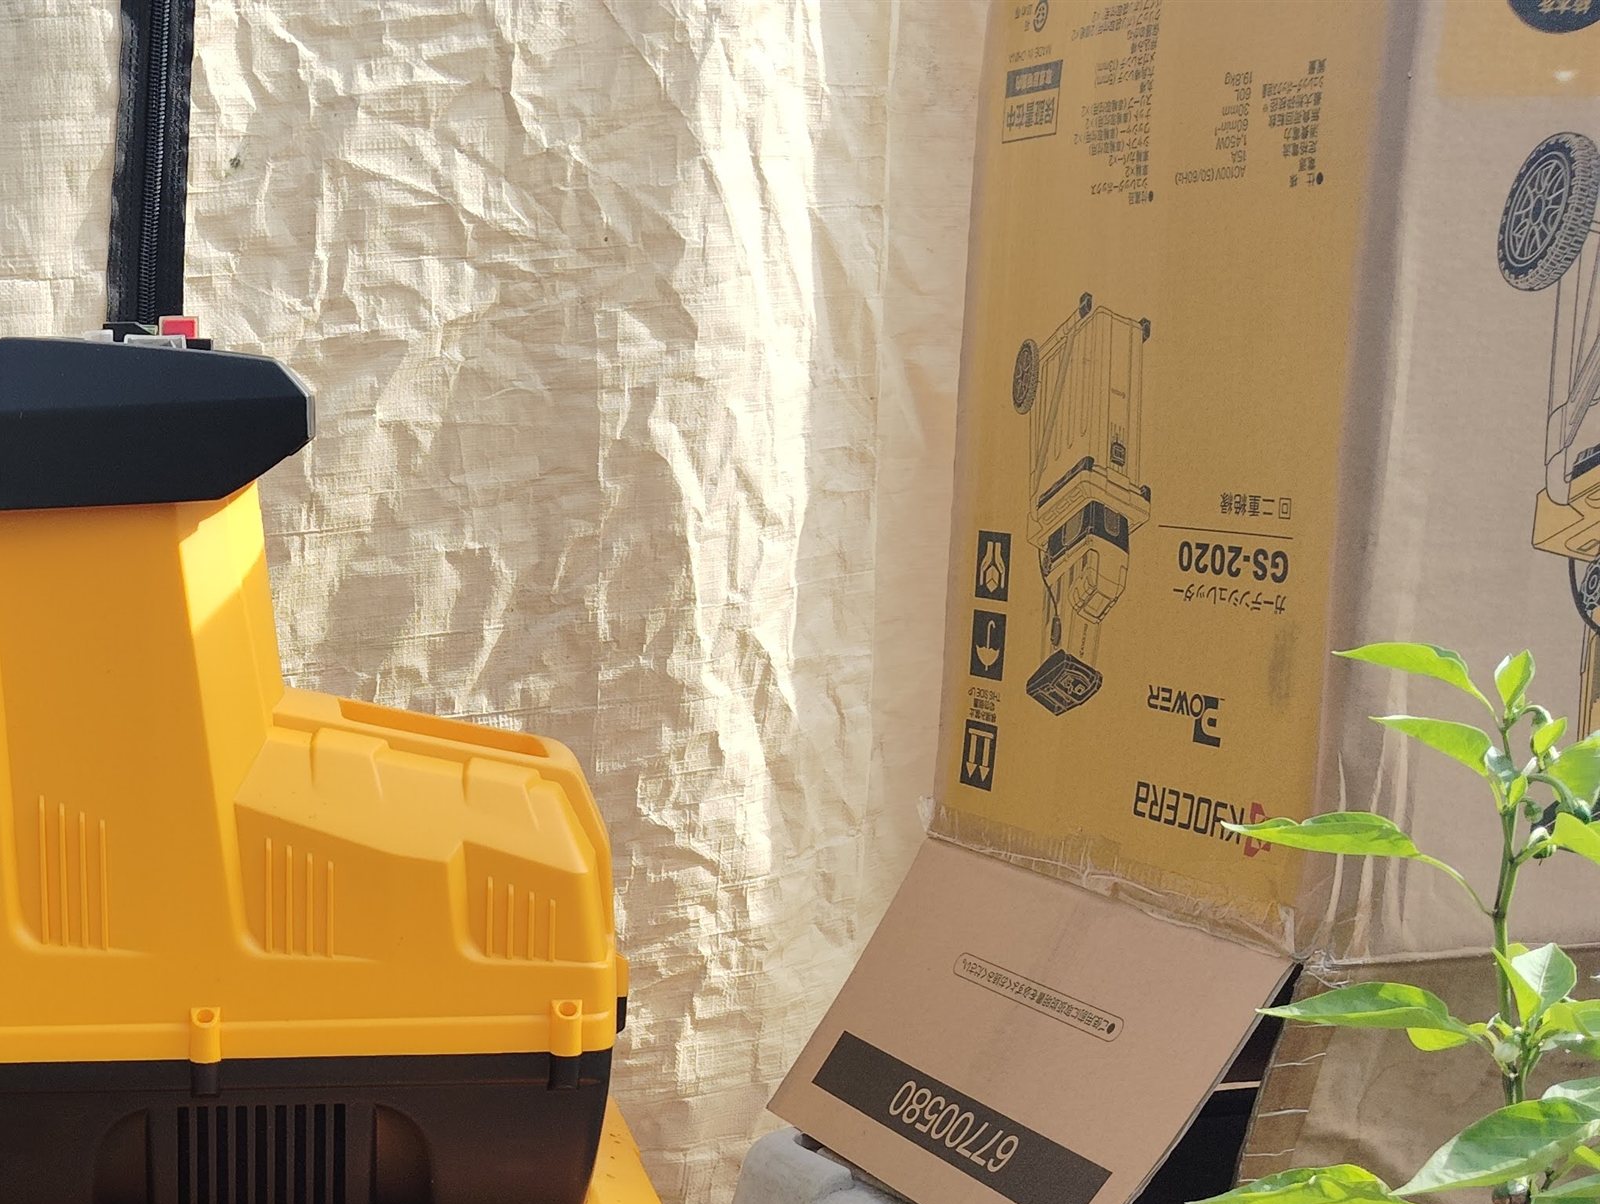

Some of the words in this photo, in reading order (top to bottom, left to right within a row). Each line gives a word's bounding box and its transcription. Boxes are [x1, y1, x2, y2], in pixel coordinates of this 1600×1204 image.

[1224, 71, 1253, 86] 19.8kg
[1235, 87, 1251, 100] 60L
[1006, 97, 1055, 132] 保証書在中
[1222, 102, 1250, 116] 30mm
[1216, 135, 1247, 149] 1,450W
[1231, 150, 1246, 162] 15A
[1178, 541, 1288, 584] GS-2020
[1173, 584, 1287, 614] ガーデンシュレッダー
[1132, 781, 1244, 845] KYOCERA
[887, 1080, 1020, 1173] 67700580
